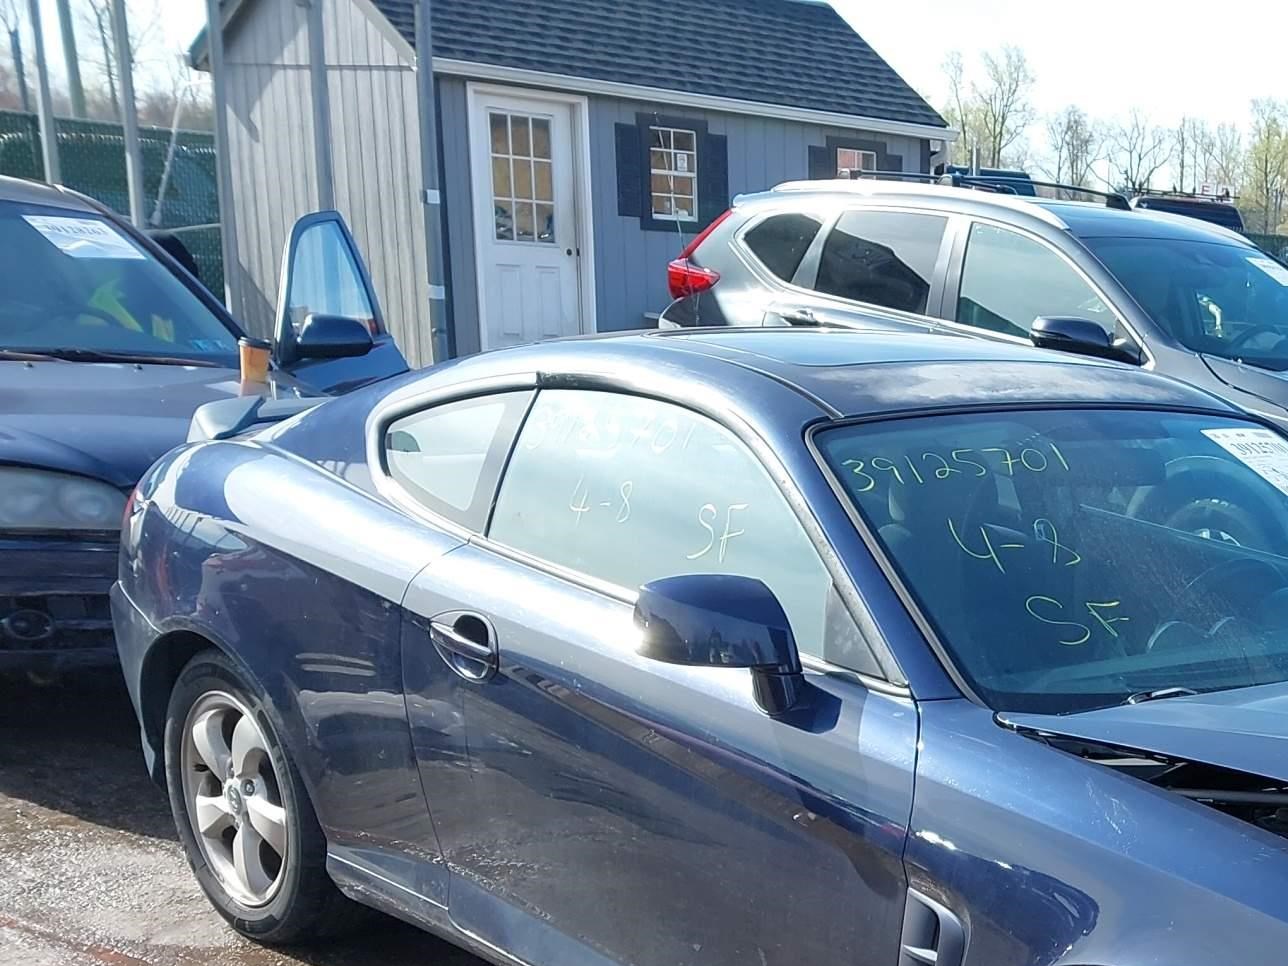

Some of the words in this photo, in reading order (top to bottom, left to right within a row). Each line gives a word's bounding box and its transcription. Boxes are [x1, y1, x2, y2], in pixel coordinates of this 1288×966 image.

[841, 442, 1070, 492] 39125701
[569, 473, 634, 526] 4-8
[686, 502, 750, 564] SF
[948, 517, 1082, 575] 4-8
[1025, 595, 1130, 646] SF
